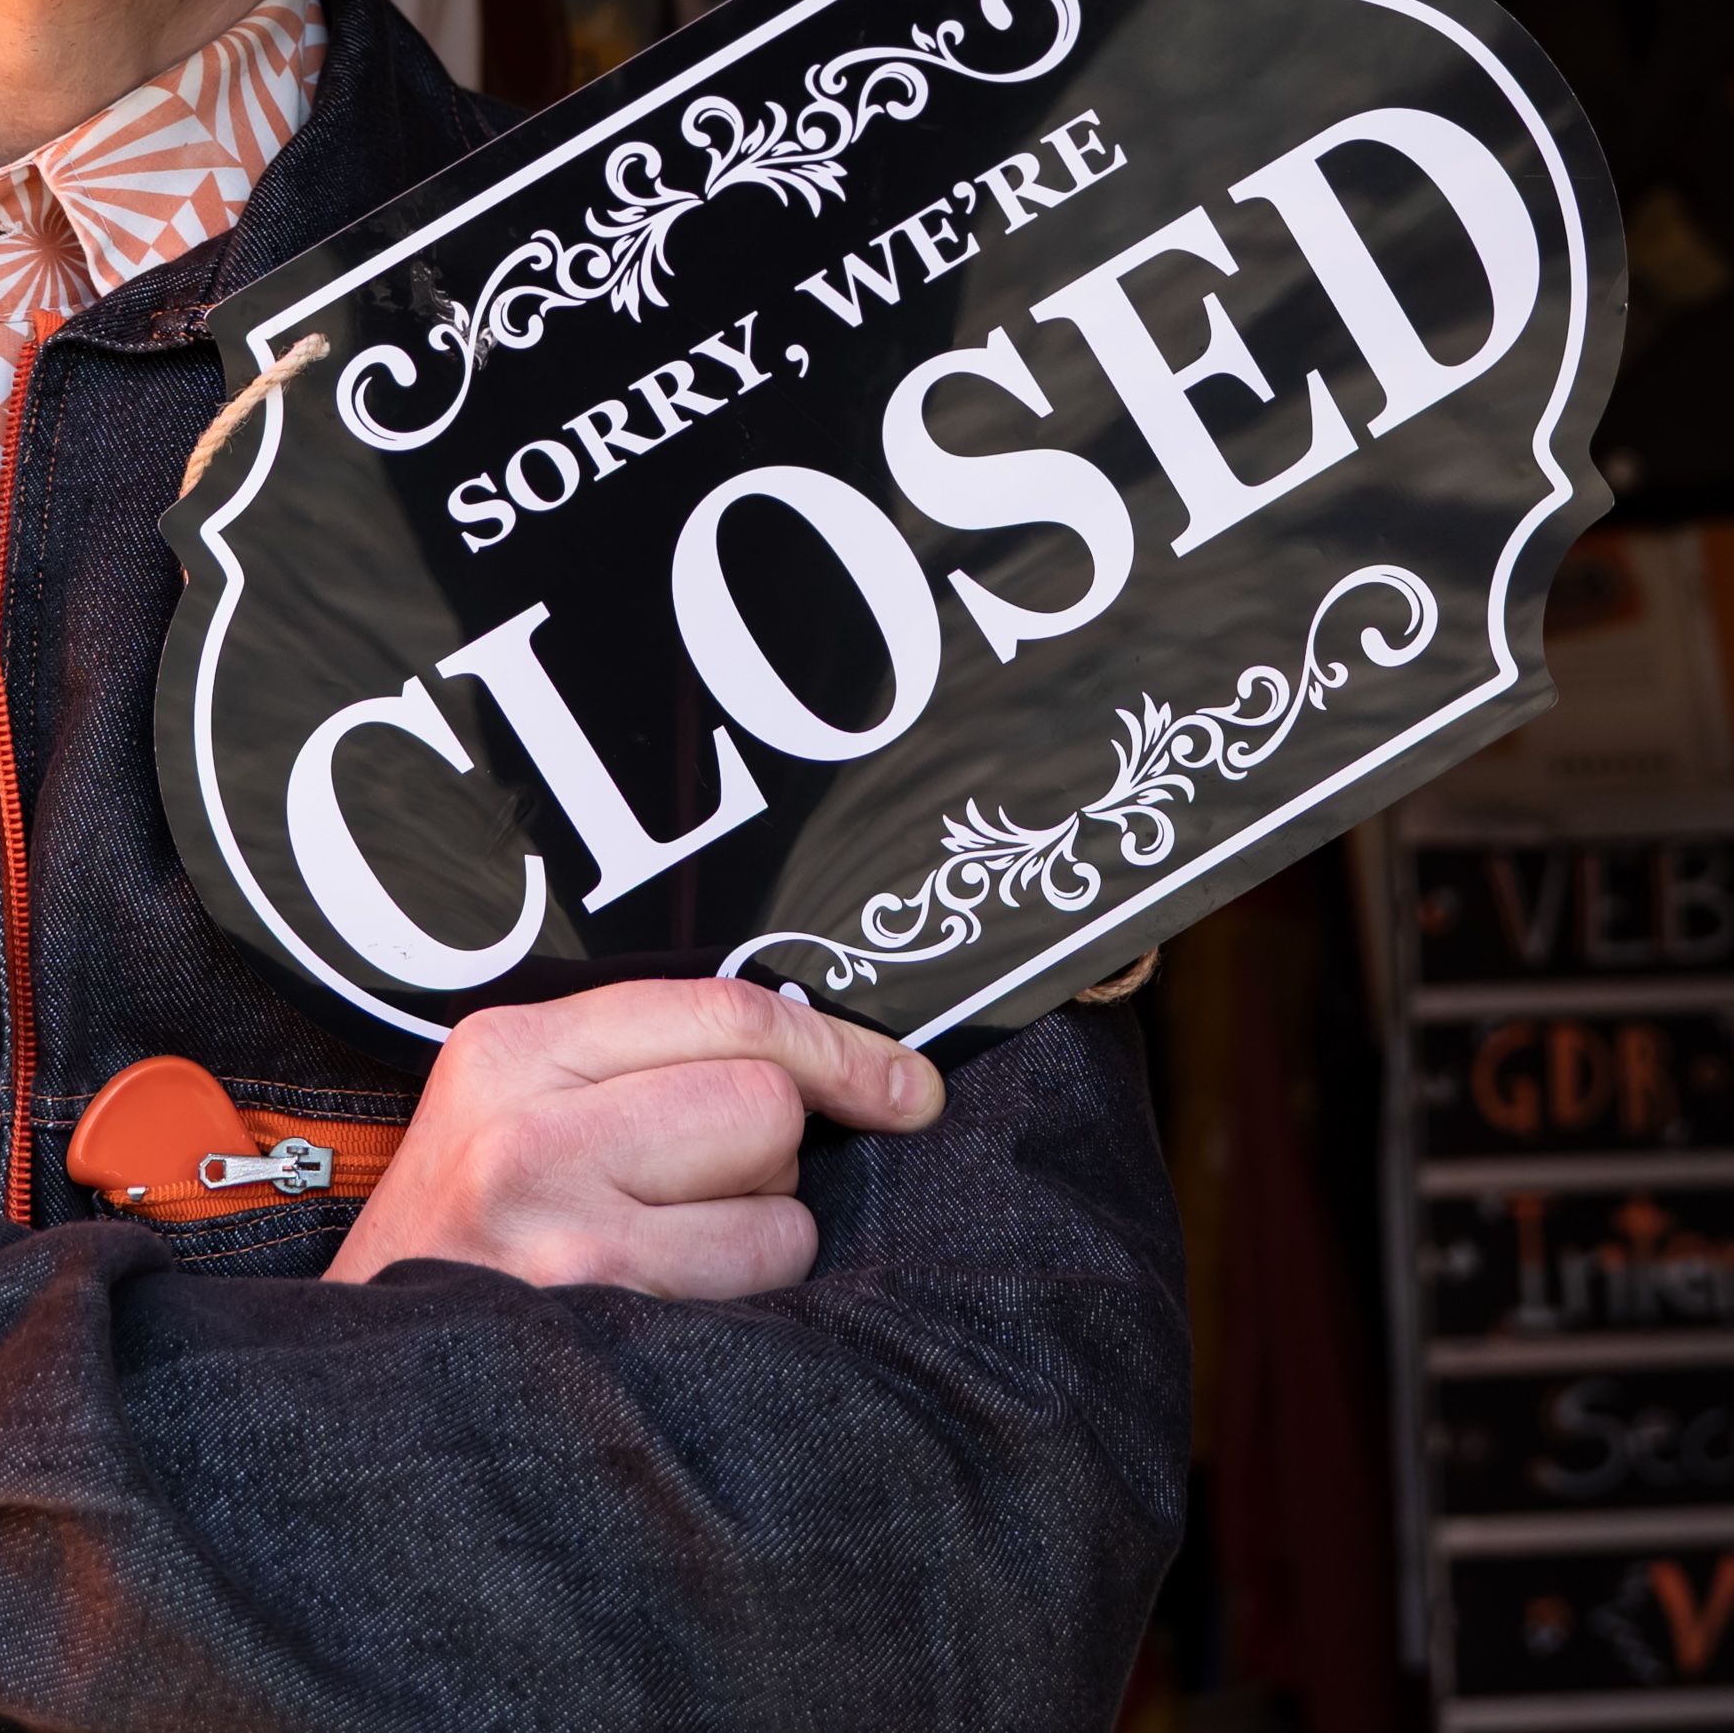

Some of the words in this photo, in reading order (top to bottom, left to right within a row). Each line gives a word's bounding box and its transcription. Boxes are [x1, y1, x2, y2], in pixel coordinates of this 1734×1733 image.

[287, 108, 1540, 989] CLOSED
[447, 310, 810, 554] SORRY,
[794, 108, 1128, 328] WE'RE
